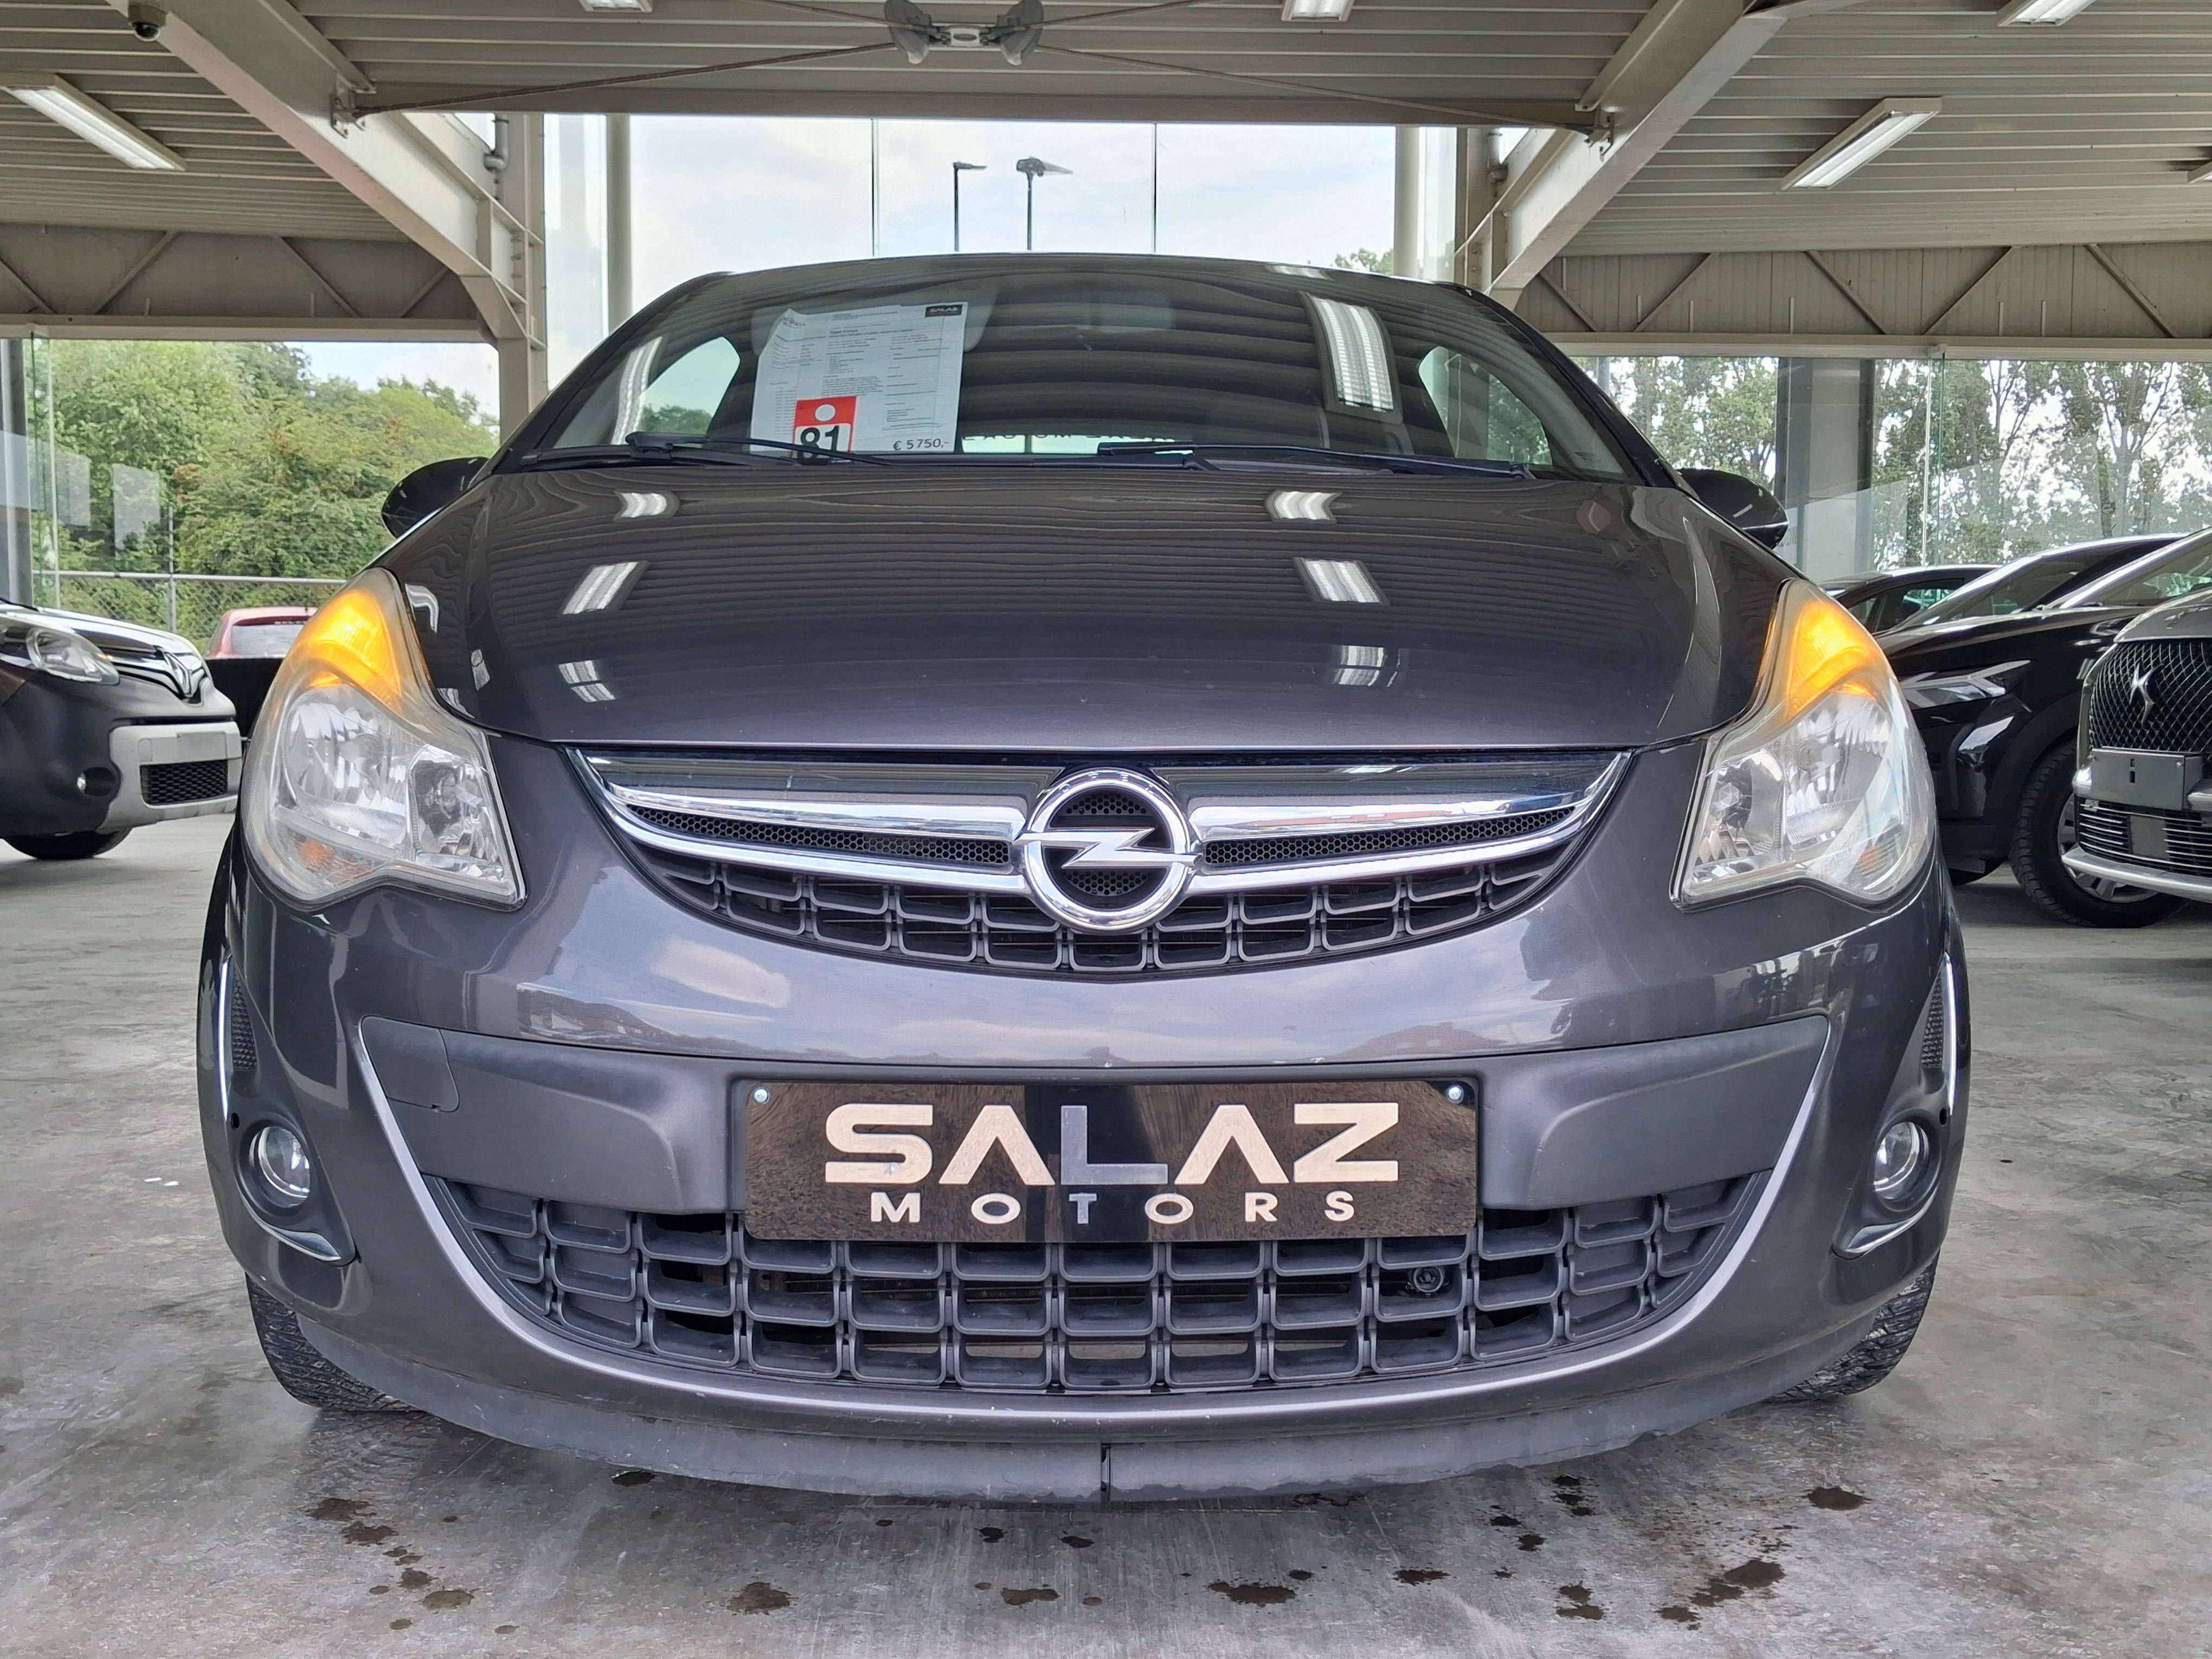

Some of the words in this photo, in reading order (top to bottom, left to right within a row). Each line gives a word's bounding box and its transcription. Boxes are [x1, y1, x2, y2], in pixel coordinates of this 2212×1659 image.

[893, 440, 902, 451] €
[825, 1103, 1399, 1186] SALAZ
[870, 1191, 1355, 1224] MOTORS
